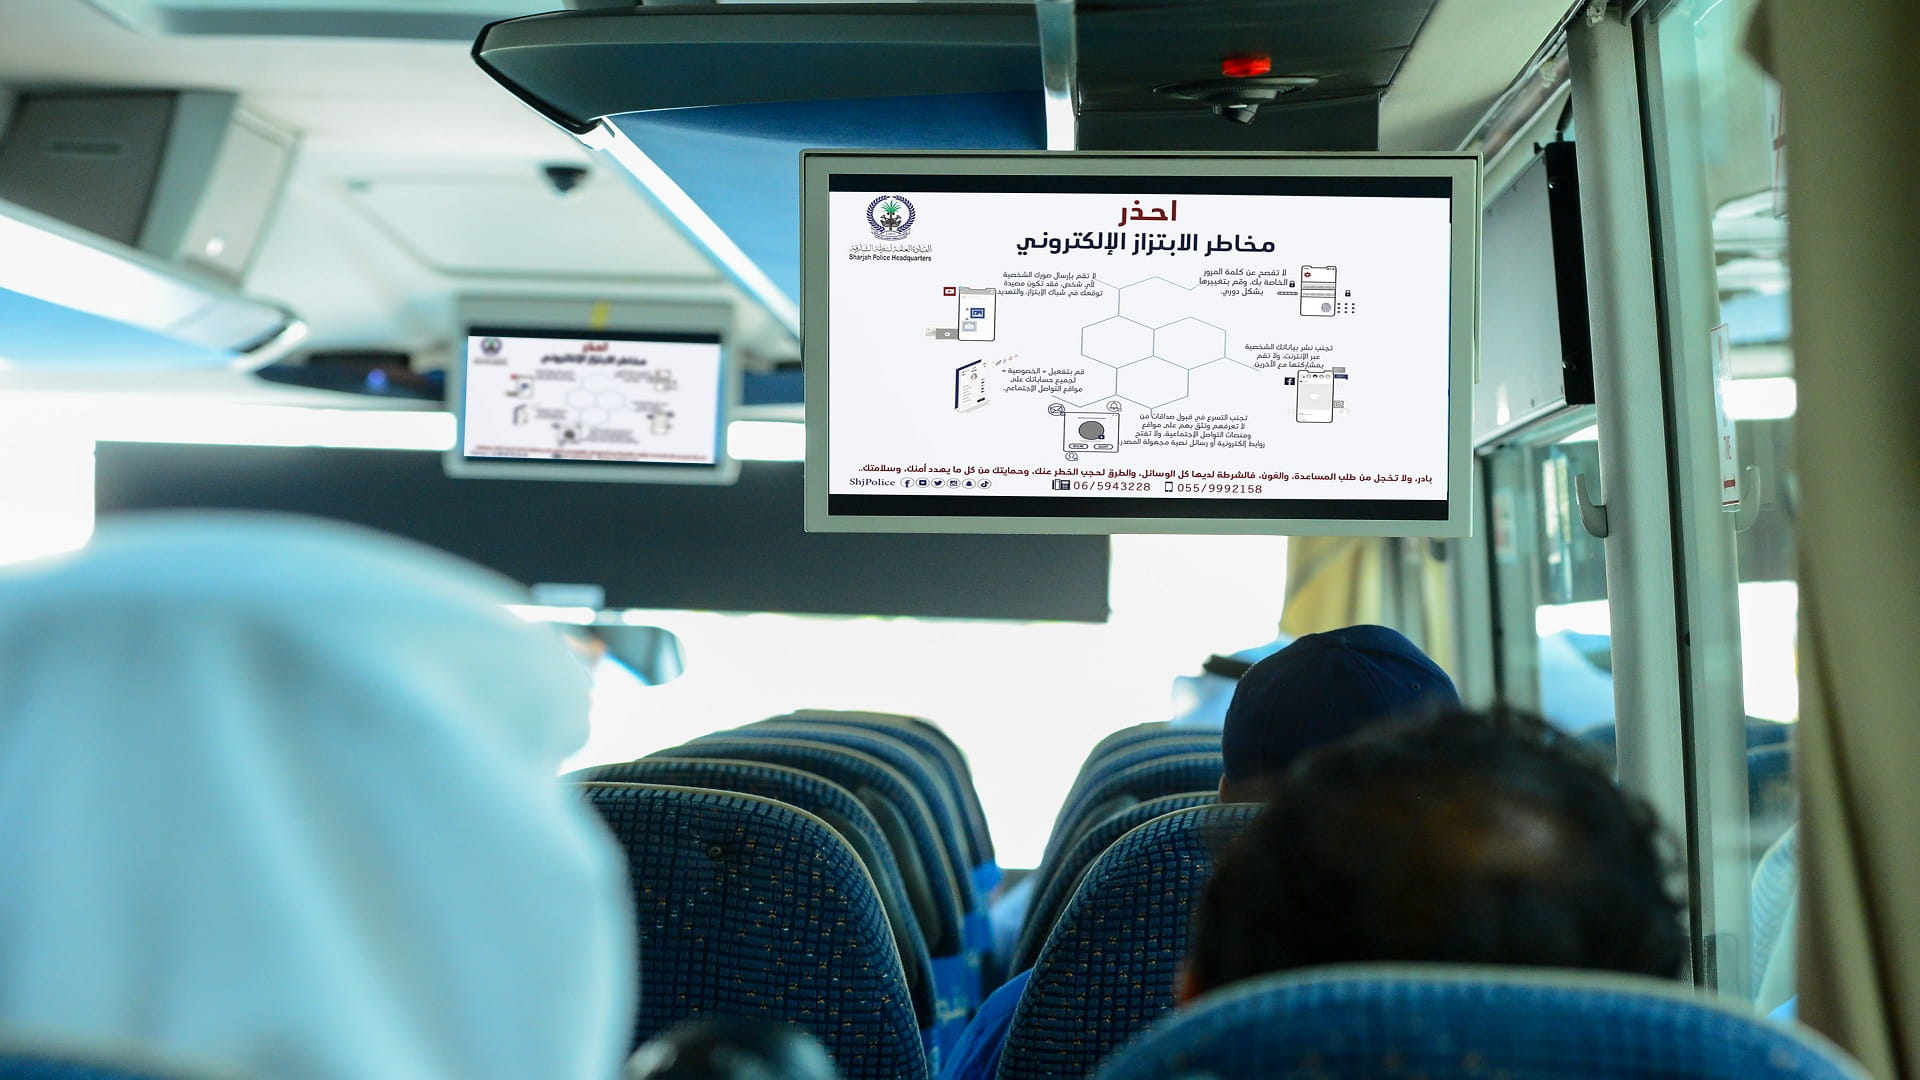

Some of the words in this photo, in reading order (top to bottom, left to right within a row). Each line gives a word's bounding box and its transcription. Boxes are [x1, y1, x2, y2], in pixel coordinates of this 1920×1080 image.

[1118, 200, 1176, 227] احذر
[1016, 232, 1125, 256] الإلكتروني
[1132, 233, 1198, 256] الابتزاز
[1205, 235, 1275, 256] مخاطر
[1034, 272, 1052, 280] صورك
[1204, 268, 1222, 276] المرور
[1258, 270, 1279, 278] تفصح
[1200, 277, 1229, 286] بتغييرها
[1068, 290, 1078, 298] في
[1242, 288, 1263, 296] بشكل
[1276, 344, 1298, 352] بياناتك
[1300, 344, 1313, 352] نشر
[1289, 361, 1324, 369] بمشاركتها
[1048, 368, 1072, 376] بتفعيل
[1074, 368, 1085, 376] قم
[1010, 375, 1023, 383] على
[1025, 376, 1053, 384] حساباتك
[1055, 377, 1076, 385] لجميع
[1038, 385, 1062, 393] التواصل
[1063, 386, 1083, 394] مواقع
[1176, 414, 1193, 422] قبول
[1194, 414, 1206, 422] في
[1206, 414, 1228, 422] التسرع
[1142, 422, 1161, 430] مواقع
[1200, 431, 1224, 439] التواصل
[1225, 431, 1251, 440] ومنصات
[1210, 438, 1216, 448] أو
[1217, 440, 1246, 448] إلكترونية
[964, 466, 975, 475] كل
[992, 467, 1029, 476] وحمايتك
[1054, 468, 1078, 477] الخطر
[1081, 469, 1105, 477] لحجب
[1107, 469, 1136, 479] والطرق
[1178, 470, 1189, 479] كل
[1192, 470, 1214, 479] لديها
[1217, 471, 1256, 481] فالشرطة
[1338, 473, 1356, 482] طلب
[1359, 473, 1371, 481] من
[1373, 474, 1399, 484] تخجل
[1400, 474, 1412, 483] ولا
[849, 478, 895, 486] ShjPolice
[1073, 481, 1151, 491] 06/5943228
[1178, 483, 1262, 494] 055/9992158
